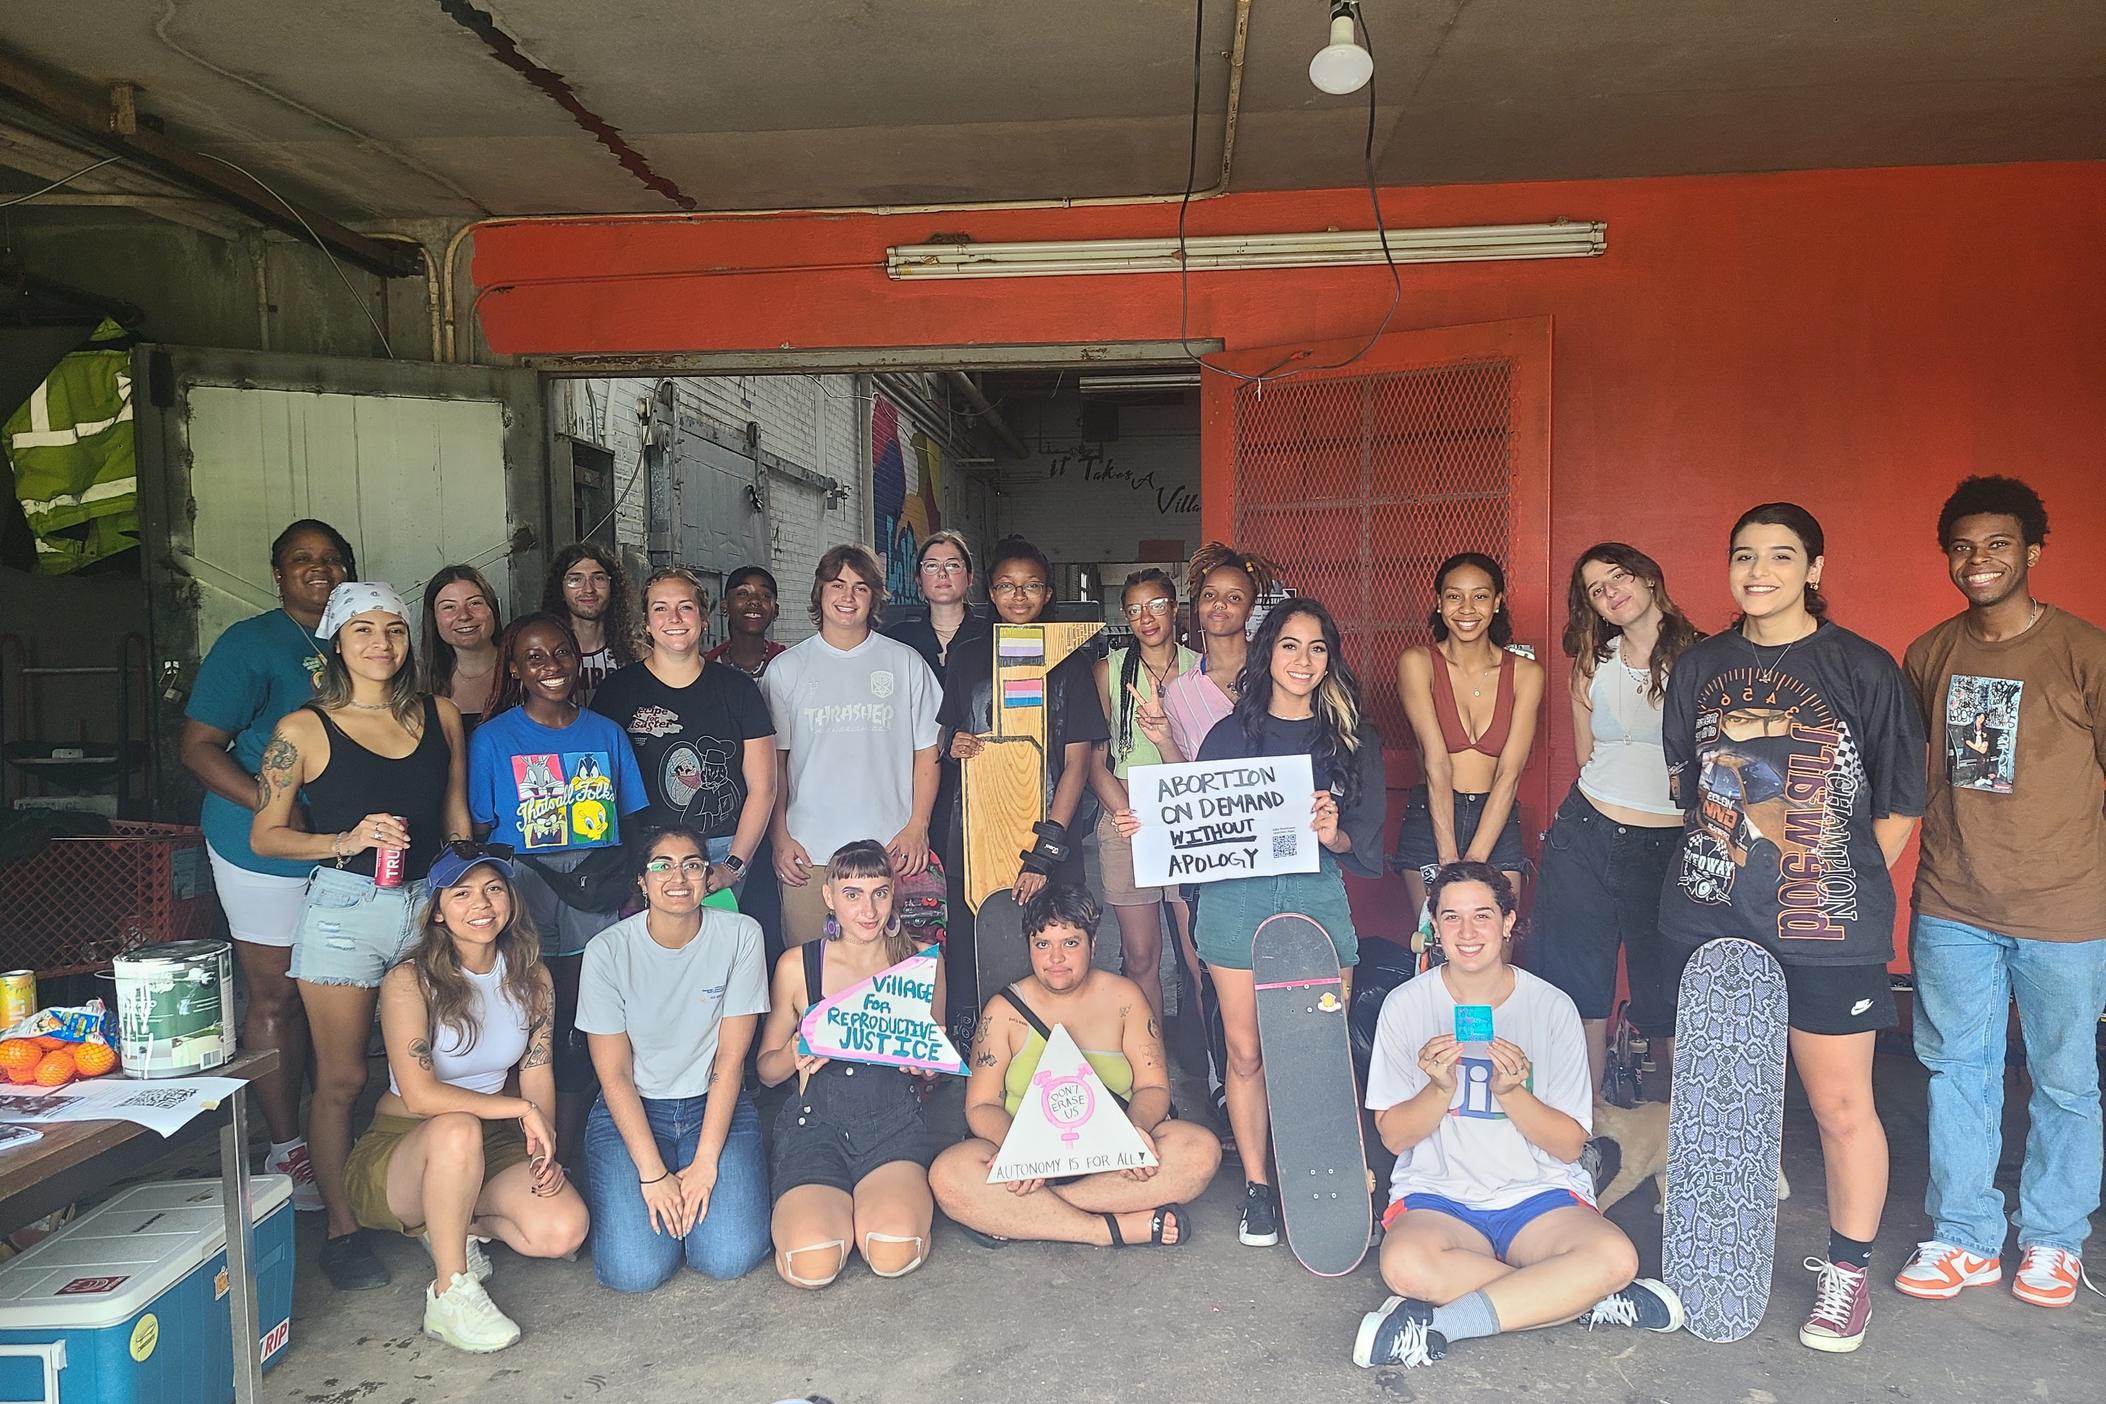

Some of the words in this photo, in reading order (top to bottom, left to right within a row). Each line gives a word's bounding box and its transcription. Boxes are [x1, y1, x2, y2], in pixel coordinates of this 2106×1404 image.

[1156, 485, 1202, 515] Villa
[804, 702, 895, 731] THRASHER
[1157, 765, 1277, 803] ABORTION
[1161, 802, 1193, 825] ON
[1199, 790, 1285, 819] DEMAND
[1169, 818, 1256, 847] WITHOUT
[1816, 770, 1859, 922] CHAMPION
[385, 849, 401, 879] TRU
[1168, 848, 1259, 878] APOLOGY
[827, 1006, 940, 1042] REPRODUCTIVE
[839, 1026, 944, 1061] JUSTICE
[1050, 1084, 1080, 1103] DON'T
[1051, 1095, 1086, 1113] ERASE
[1063, 1107, 1080, 1120] US
[995, 1158, 1061, 1180] AUTONOMY
[1068, 1156, 1080, 1171] IS
[1086, 1154, 1109, 1169] FOR
